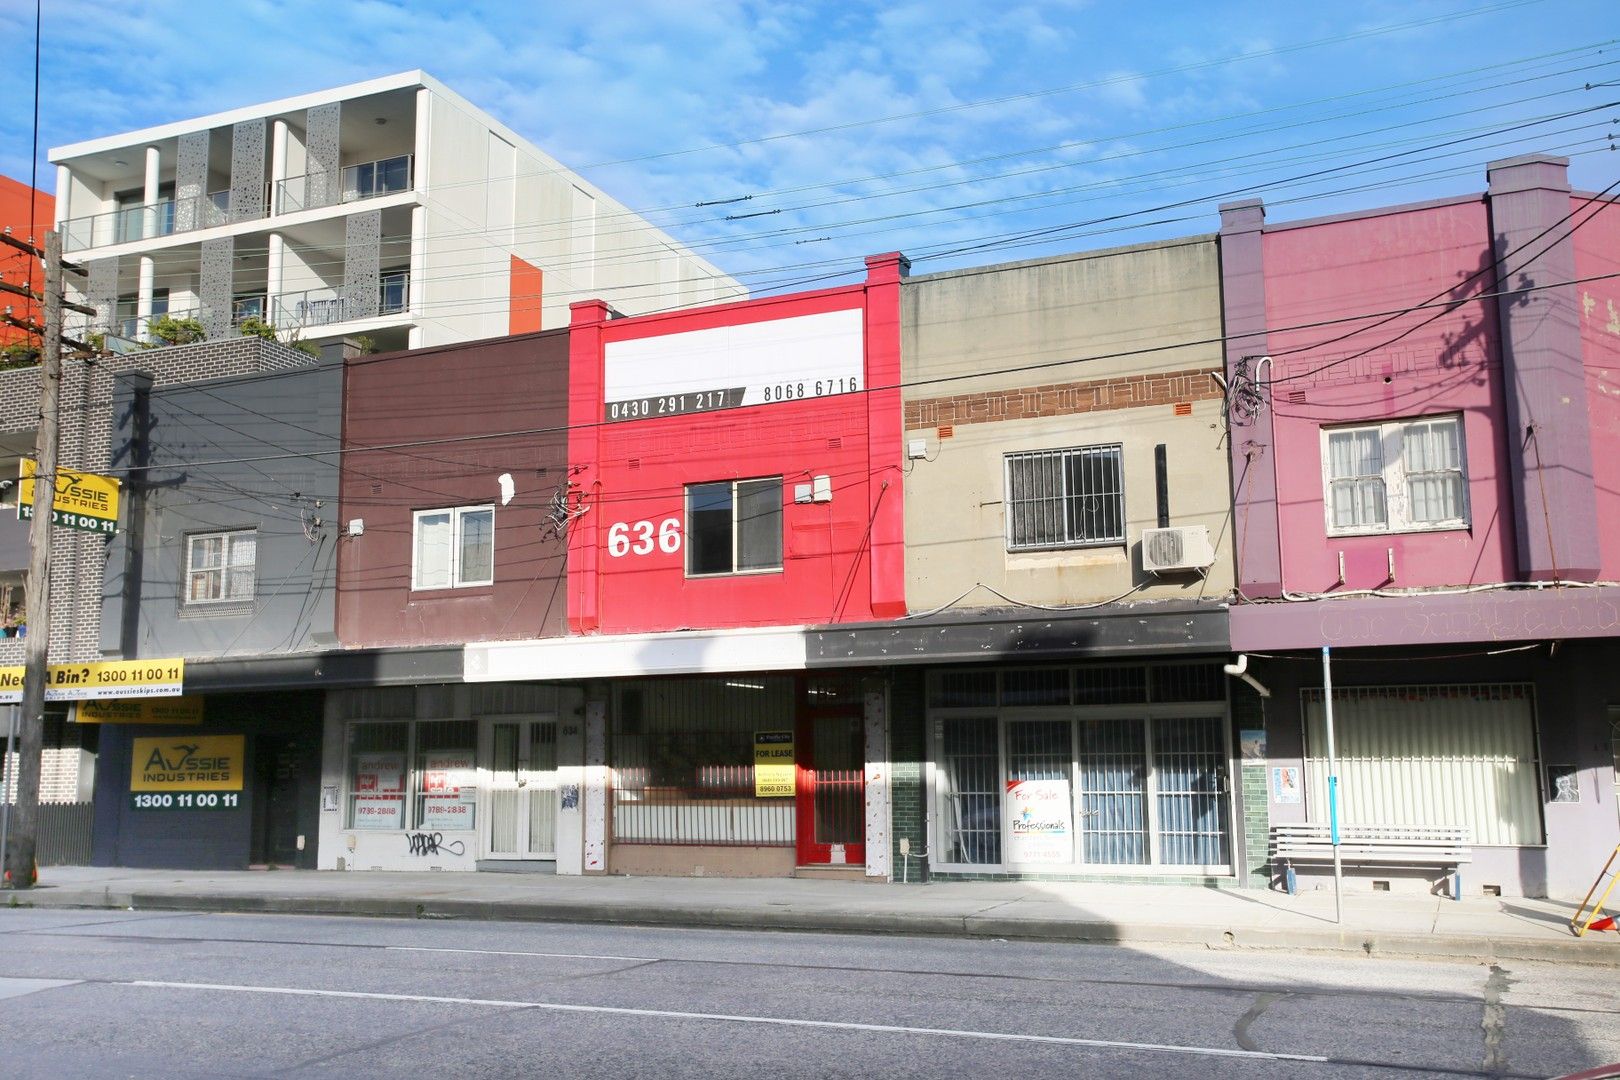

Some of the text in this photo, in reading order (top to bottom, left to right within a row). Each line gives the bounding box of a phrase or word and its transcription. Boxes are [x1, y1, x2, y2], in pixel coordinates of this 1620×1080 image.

[764, 376, 857, 401] 8068 6716
[611, 391, 725, 419] 0430 291 217
[62, 513, 77, 526] 11
[79, 516, 97, 528] 00
[100, 520, 114, 532] 11
[607, 517, 682, 558] 636
[56, 668, 90, 684] Bin?
[97, 671, 127, 683] 1300
[132, 669, 143, 681] 11
[146, 668, 163, 680] 00
[167, 667, 179, 680] 11
[756, 750, 793, 758] FOR LEASE
[143, 772, 230, 782] INDUSTRIES
[134, 793, 238, 807] 1300 11 00 11
[1015, 789, 1057, 800] For Sale
[1012, 819, 1066, 832] Professionals
